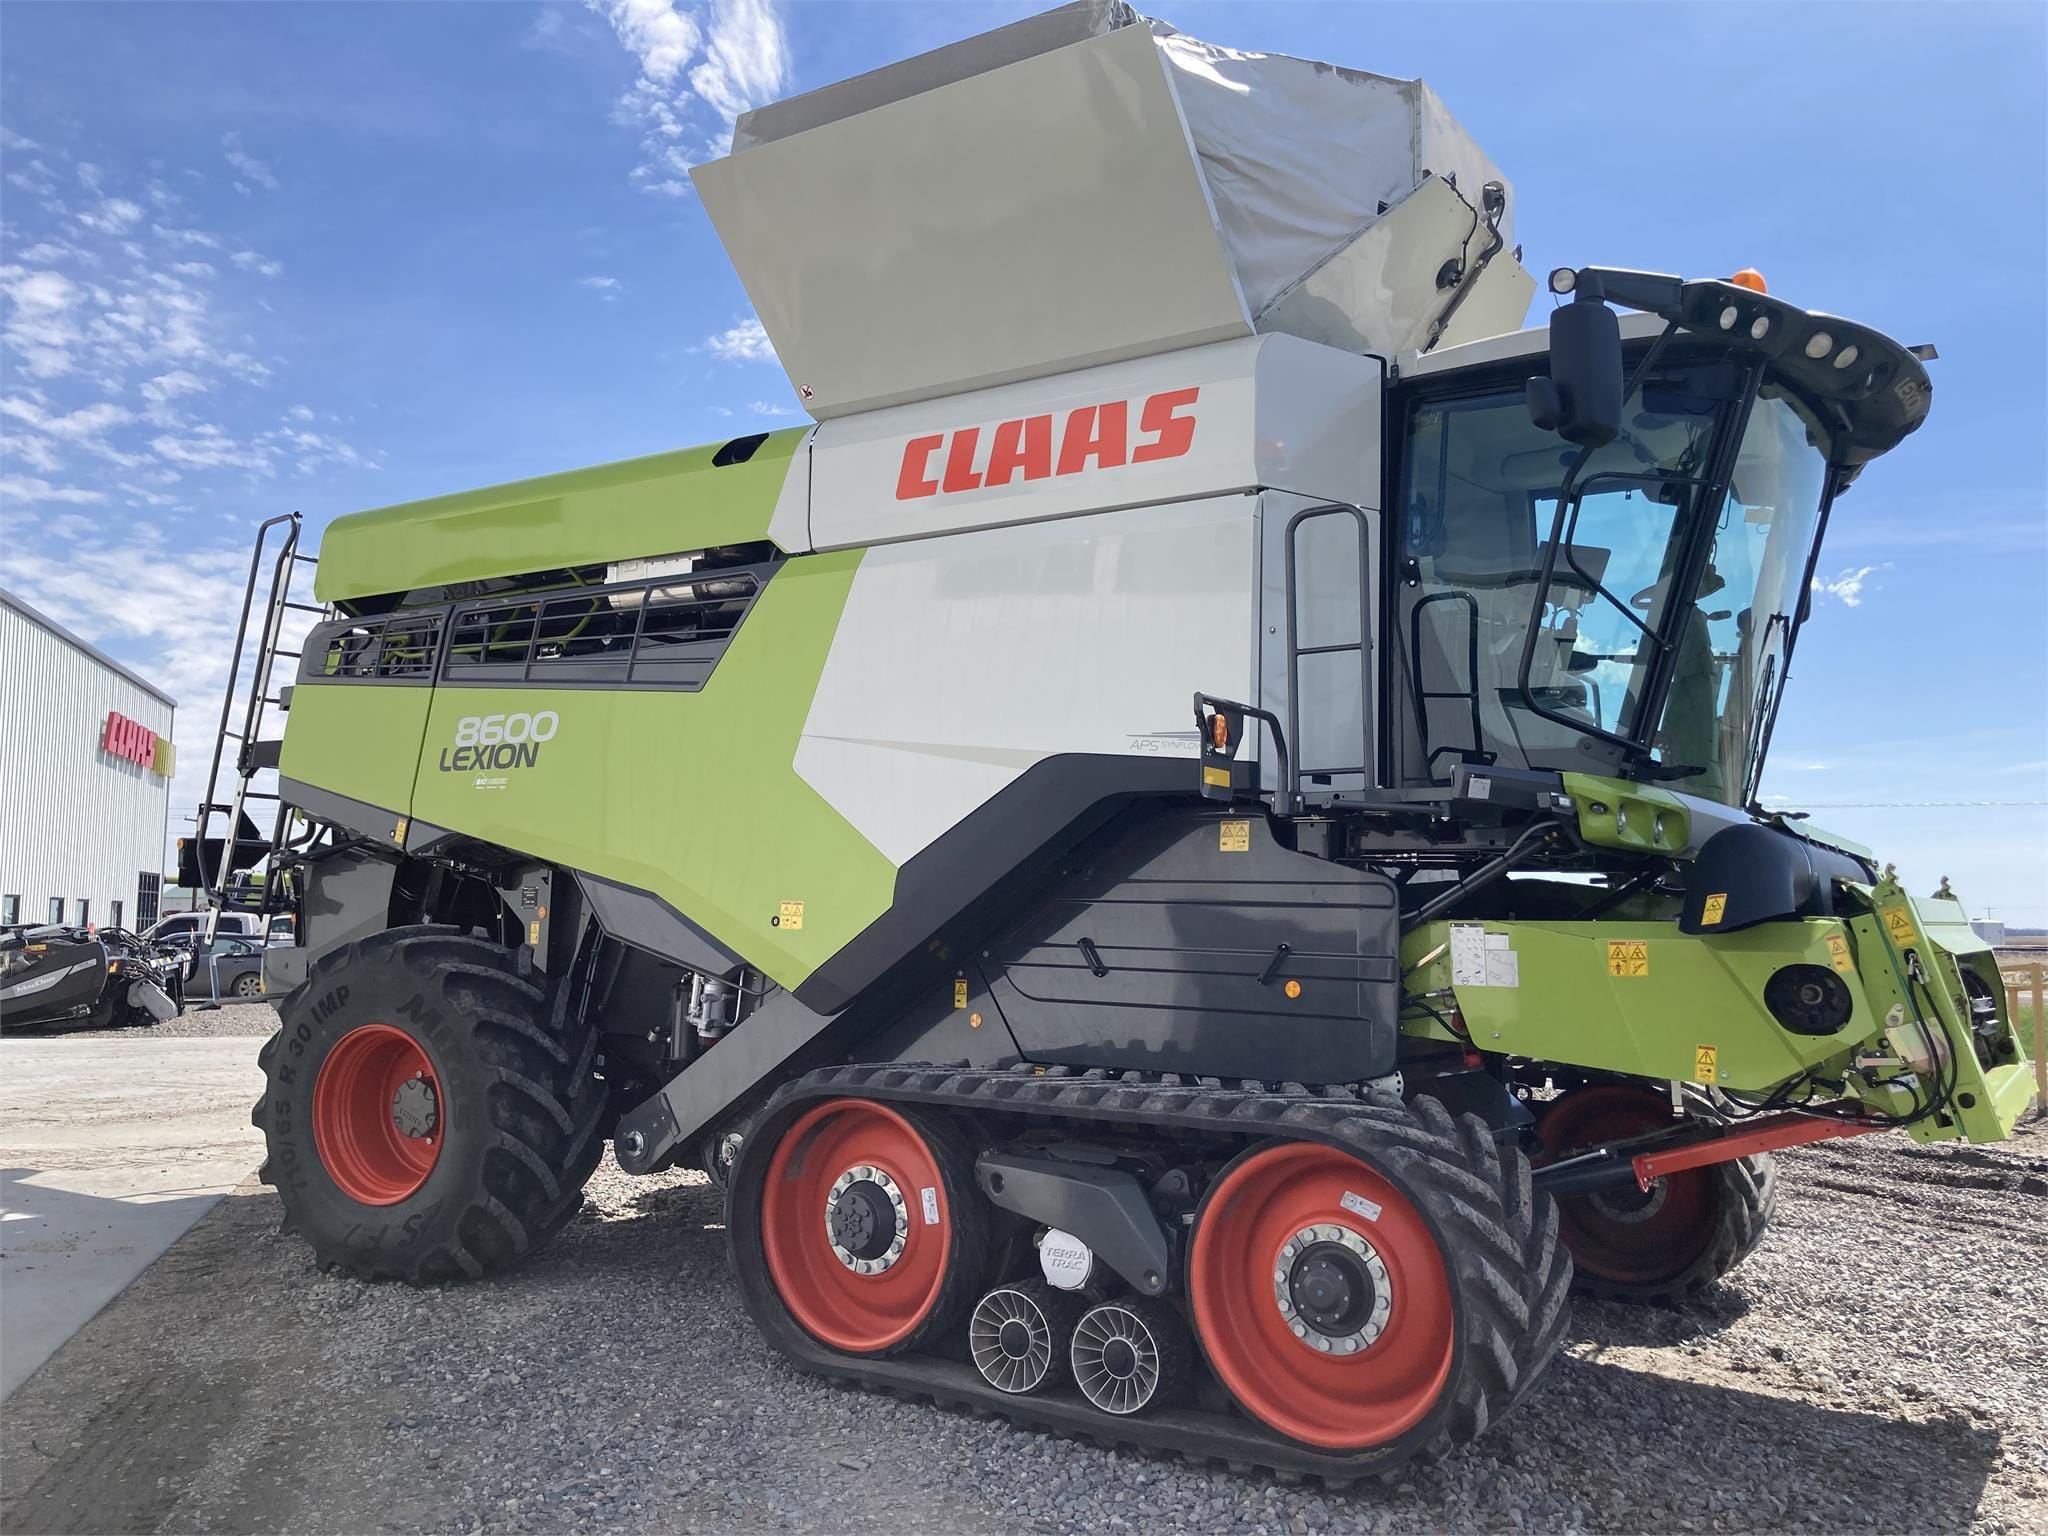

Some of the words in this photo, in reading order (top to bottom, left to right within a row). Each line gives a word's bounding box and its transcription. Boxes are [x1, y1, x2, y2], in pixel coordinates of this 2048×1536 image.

[896, 386, 1200, 500] CLAAS
[103, 711, 158, 768] CLAAS
[455, 710, 559, 747] 8600
[440, 741, 540, 772] LEXION
[1129, 740, 1160, 752] APS
[16, 977, 56, 992] MacDon
[279, 1064, 296, 1085] R
[289, 1023, 312, 1057] 30
[311, 985, 349, 1024] IMP
[1045, 1247, 1086, 1261] TERRA
[1051, 1258, 1083, 1270] TRAC
